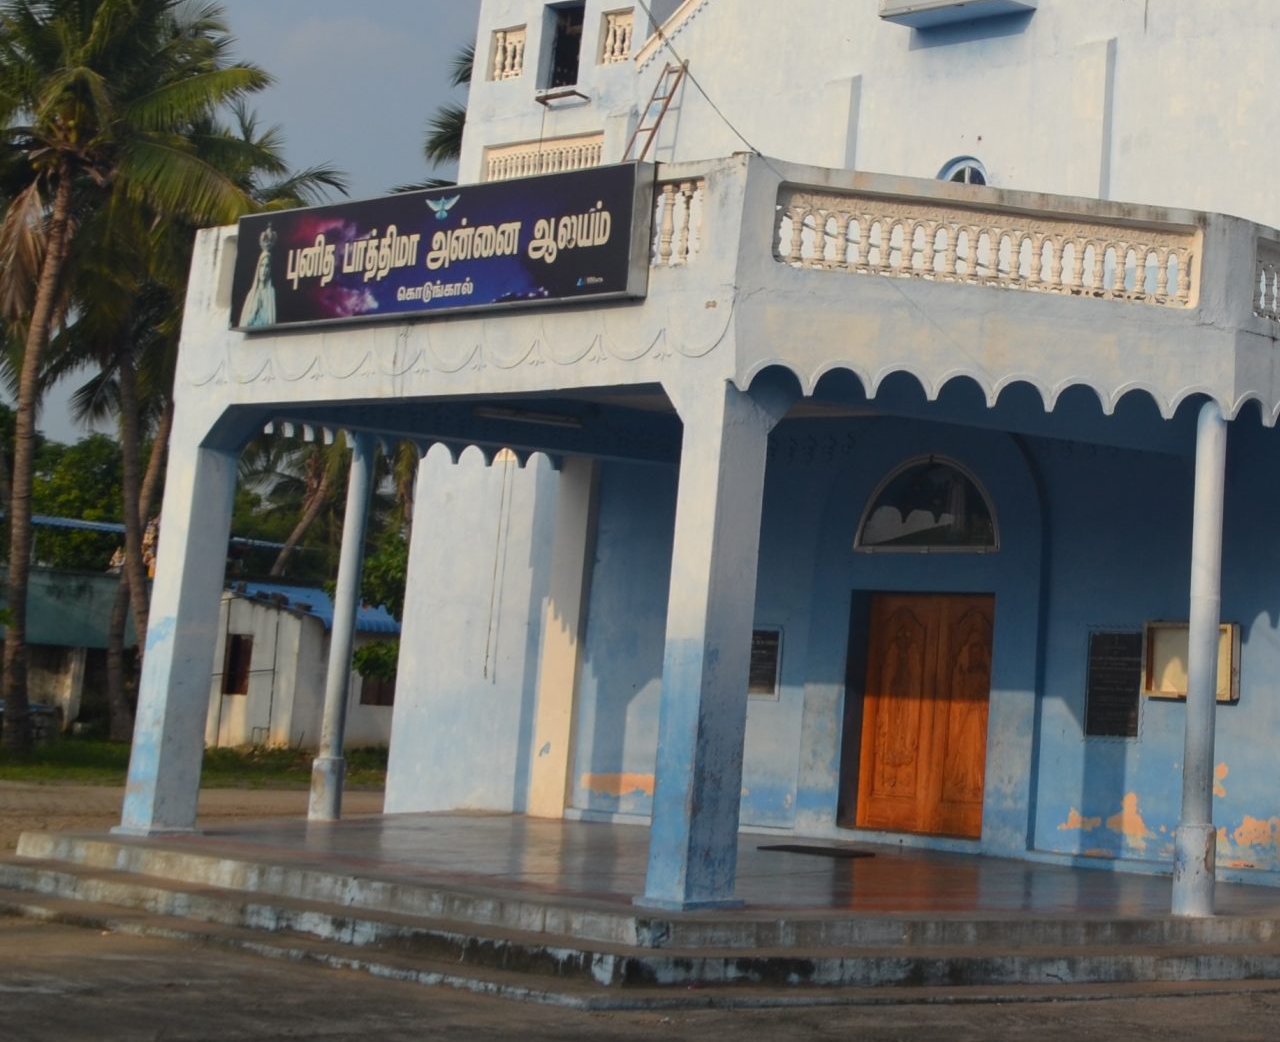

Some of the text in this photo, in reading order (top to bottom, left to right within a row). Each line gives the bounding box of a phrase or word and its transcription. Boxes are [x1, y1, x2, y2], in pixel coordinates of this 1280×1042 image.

[286, 200, 611, 290] புனித பாத்திமா அன்னை ஆலயம்
[397, 277, 473, 303] கொடுங்கால்
